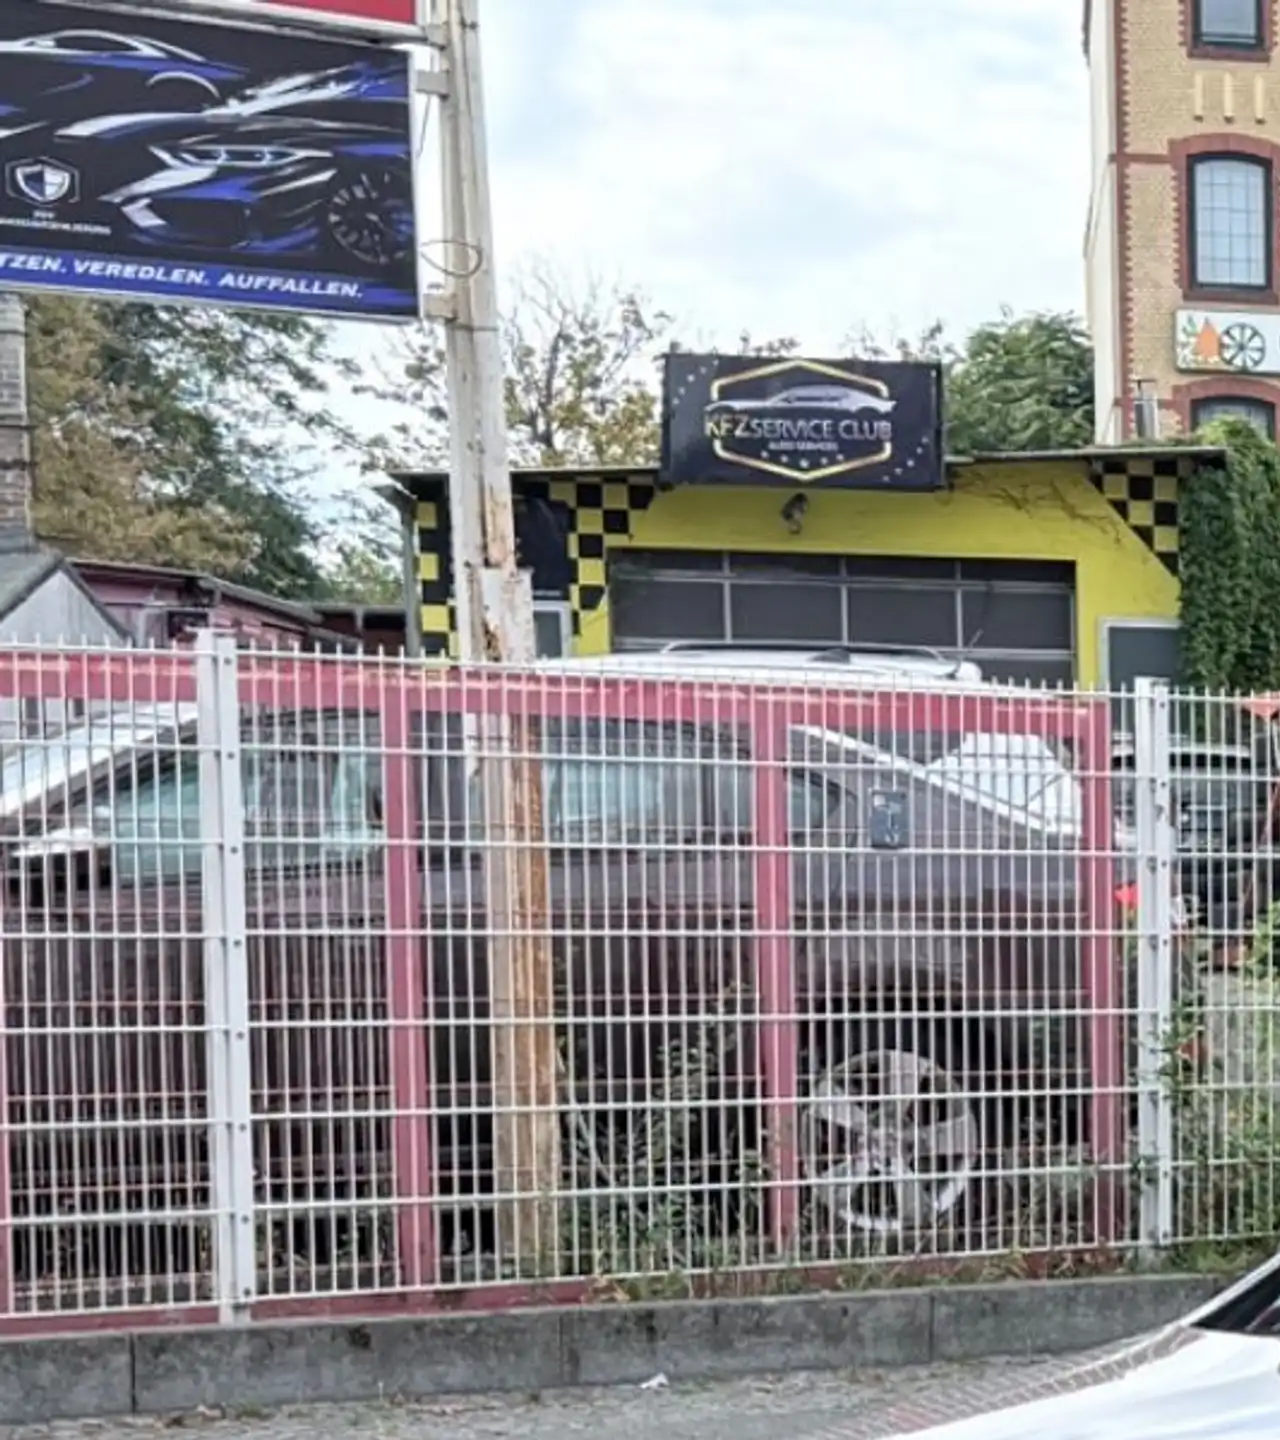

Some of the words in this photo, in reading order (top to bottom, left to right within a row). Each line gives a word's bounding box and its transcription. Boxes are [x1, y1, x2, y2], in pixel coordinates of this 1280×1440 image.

[73, 258, 211, 286] VEREDLEN.
[217, 271, 363, 299] AUFFALLEN.
[838, 419, 892, 441] CLUB
